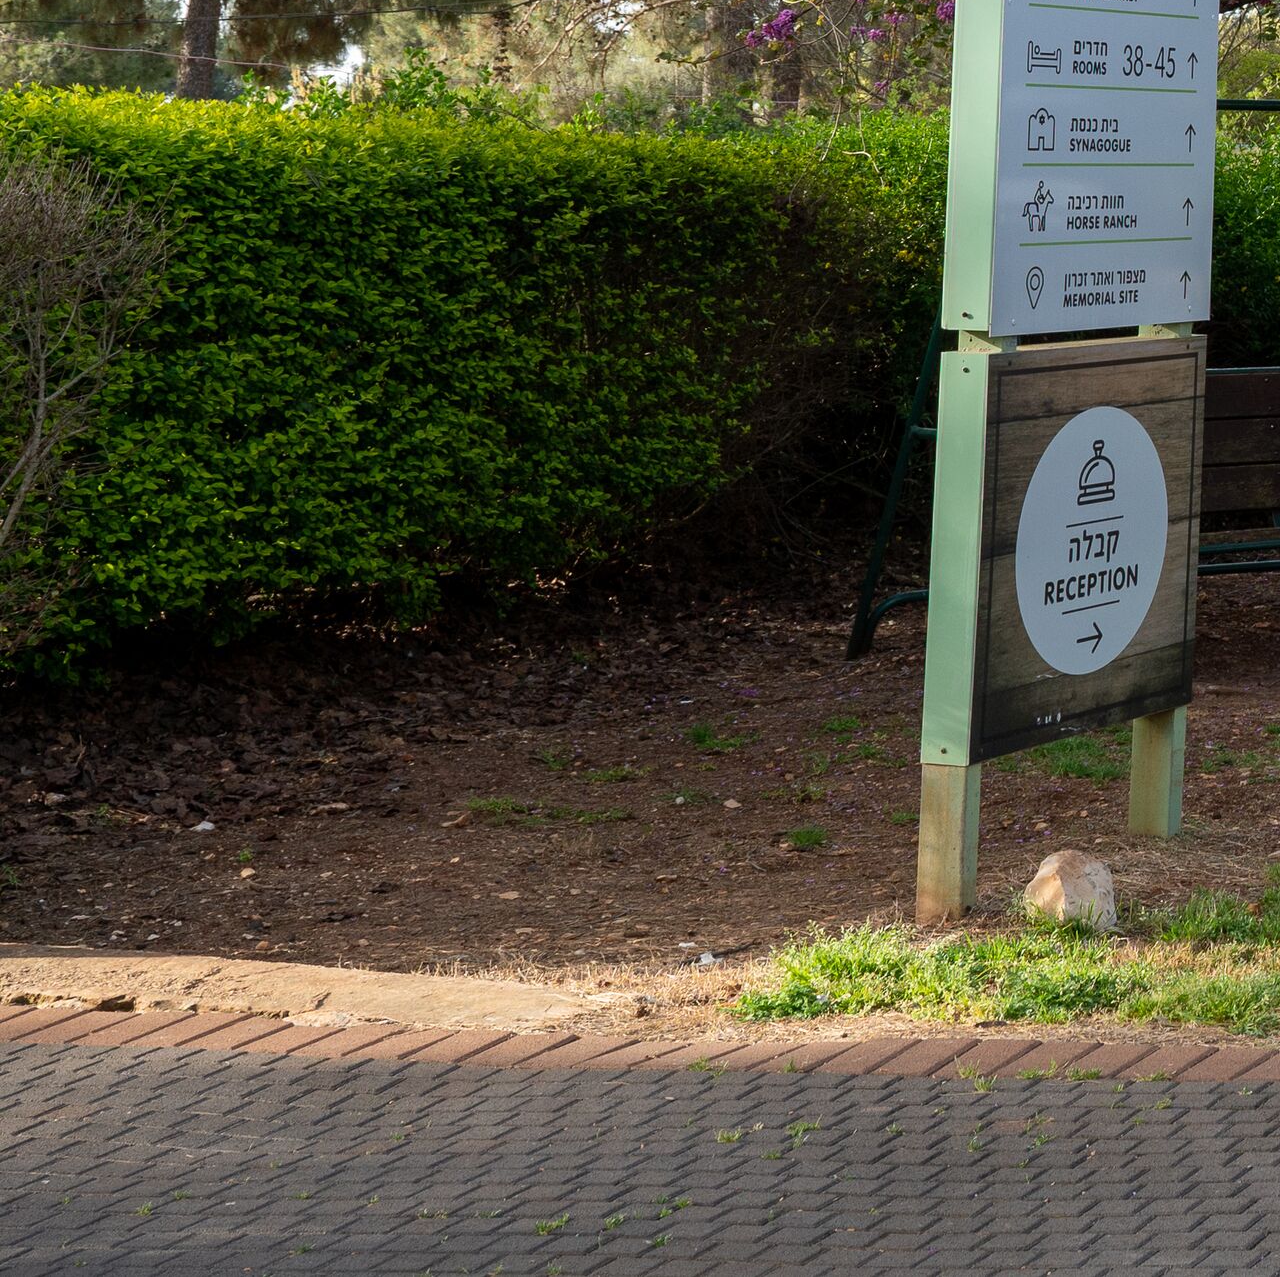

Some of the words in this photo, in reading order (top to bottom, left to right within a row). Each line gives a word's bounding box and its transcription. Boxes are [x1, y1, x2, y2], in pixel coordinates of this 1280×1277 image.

[1074, 41, 1107, 56] חדרים
[1073, 61, 1106, 75] ROOMS
[1123, 45, 1176, 78] 38-45
[1070, 118, 1097, 132] כנסת
[1101, 119, 1118, 132] בית
[1070, 138, 1130, 152] SYNAGOGUE
[1068, 196, 1098, 210] רכיבה
[1101, 195, 1124, 209] חוות
[1067, 216, 1100, 230] HORSE
[1104, 215, 1137, 228] RANCH
[1065, 273, 1087, 291] זכרון
[1091, 271, 1114, 285] ואתר
[1117, 270, 1145, 284] מצפור
[1063, 292, 1115, 307] MEMORIAL
[1119, 290, 1138, 304] SITE
[1069, 530, 1119, 563] קבלה
[1045, 564, 1138, 605] RECEPTION
